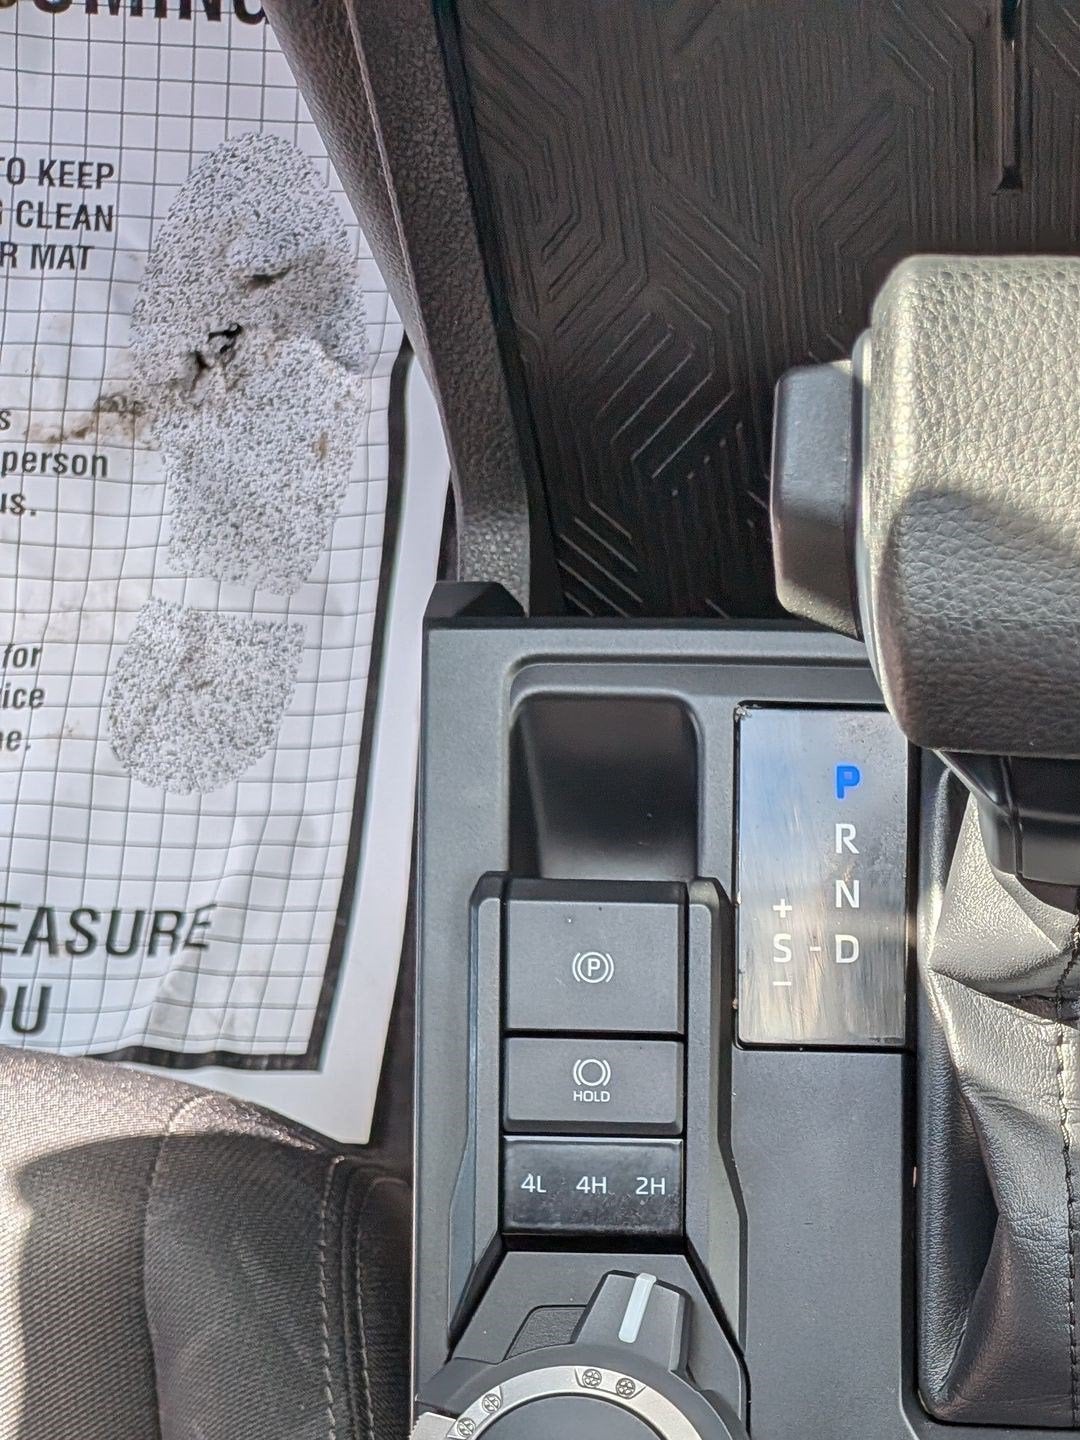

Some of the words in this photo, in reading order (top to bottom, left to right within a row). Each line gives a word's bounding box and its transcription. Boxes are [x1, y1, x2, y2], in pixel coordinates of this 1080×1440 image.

[38, 158, 115, 190] KEEP
[16, 199, 114, 232] CLEAN
[30, 243, 95, 271] MAT
[1, 450, 109, 478] person
[2, 643, 42, 669] for
[0, 682, 46, 710] ice
[834, 763, 862, 799] P
[835, 823, 860, 855] R
[835, 879, 860, 909] N
[772, 932, 792, 964] S
[835, 933, 860, 964] D
[573, 1090, 611, 1103] HOLD
[520, 1173, 547, 1193] 4L
[575, 1175, 608, 1194] 4H
[635, 1177, 666, 1195] 2H
